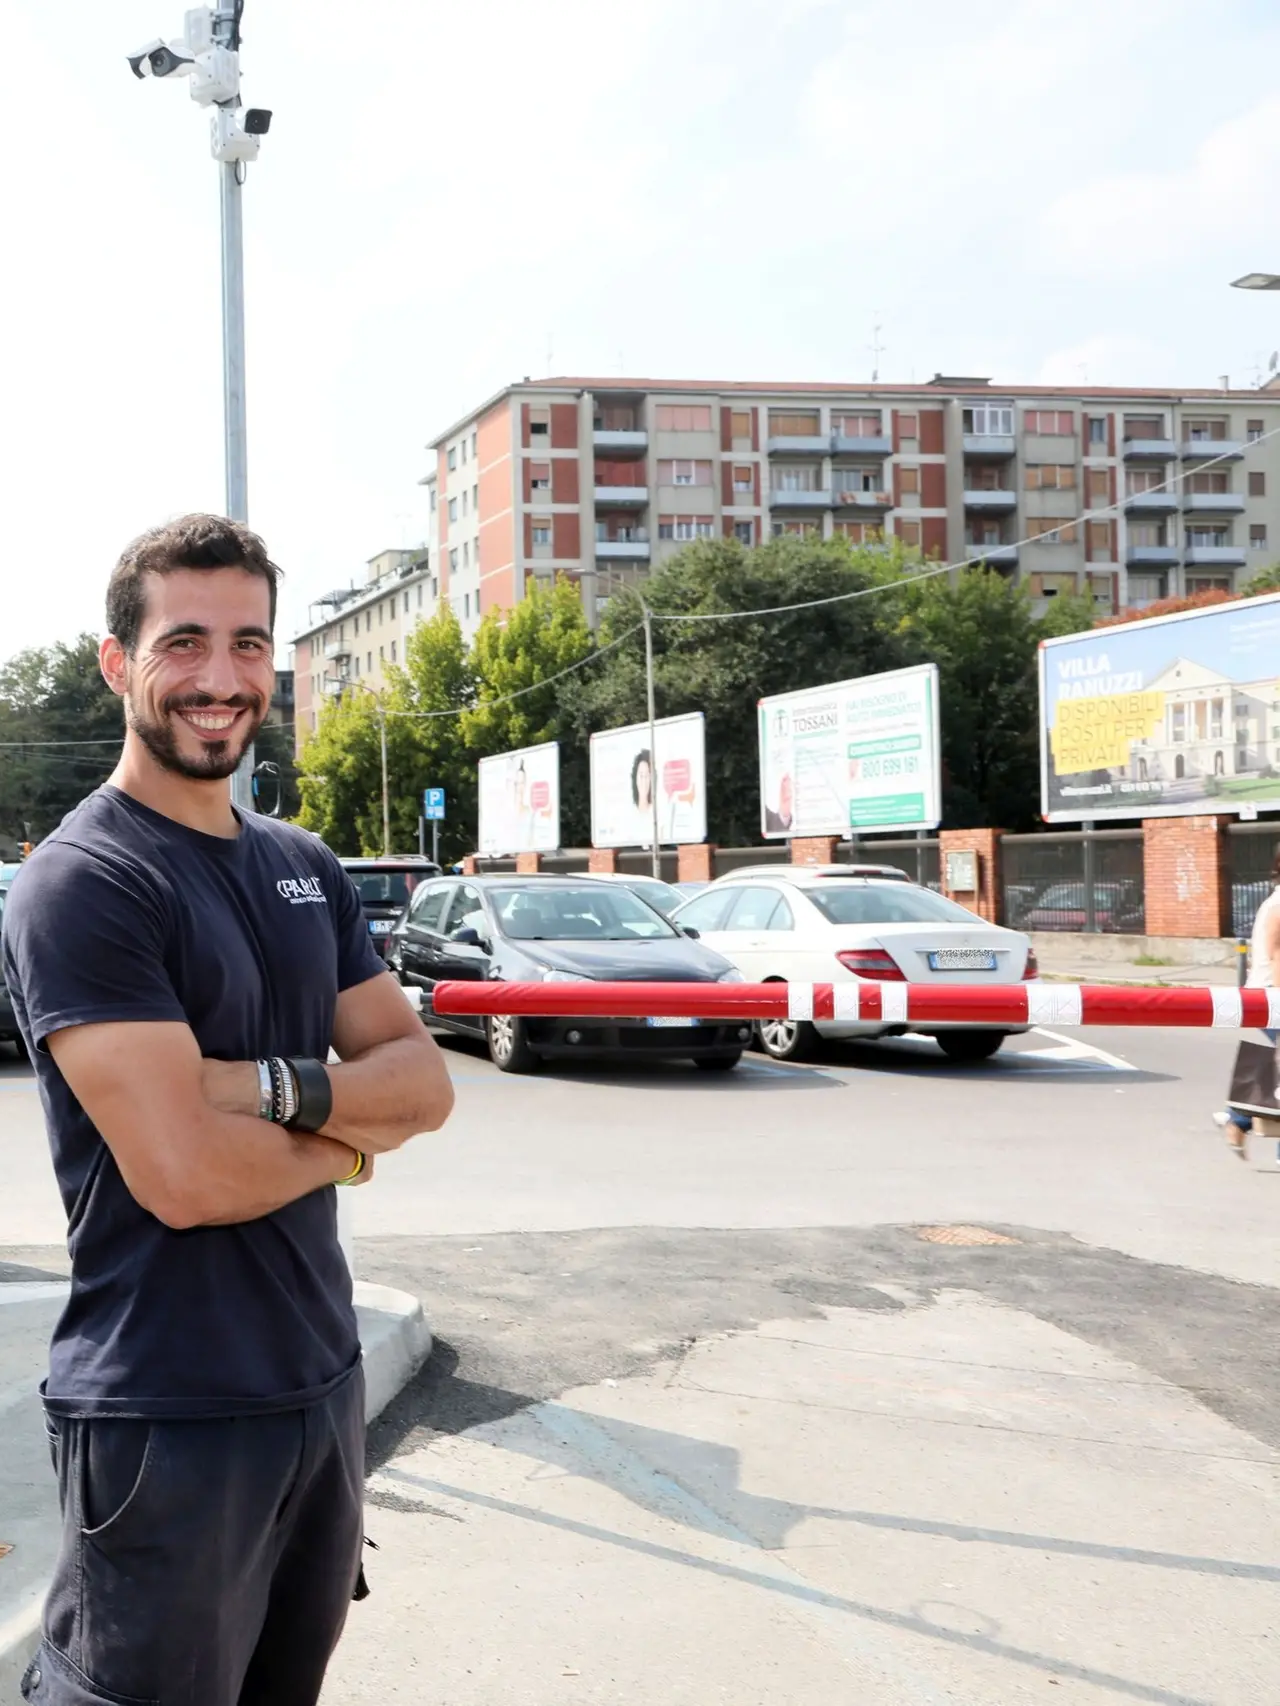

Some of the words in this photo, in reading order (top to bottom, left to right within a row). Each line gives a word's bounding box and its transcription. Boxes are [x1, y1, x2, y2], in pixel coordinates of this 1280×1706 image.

[1057, 653, 1111, 679] VILLA
[1059, 692, 1160, 723] DISPONIBILI
[792, 712, 839, 732] TOSSANI
[1060, 722, 1112, 745] POSTI
[1114, 717, 1147, 738] PER
[1060, 743, 1121, 766] PRIVATI
[430, 791, 441, 806] P
